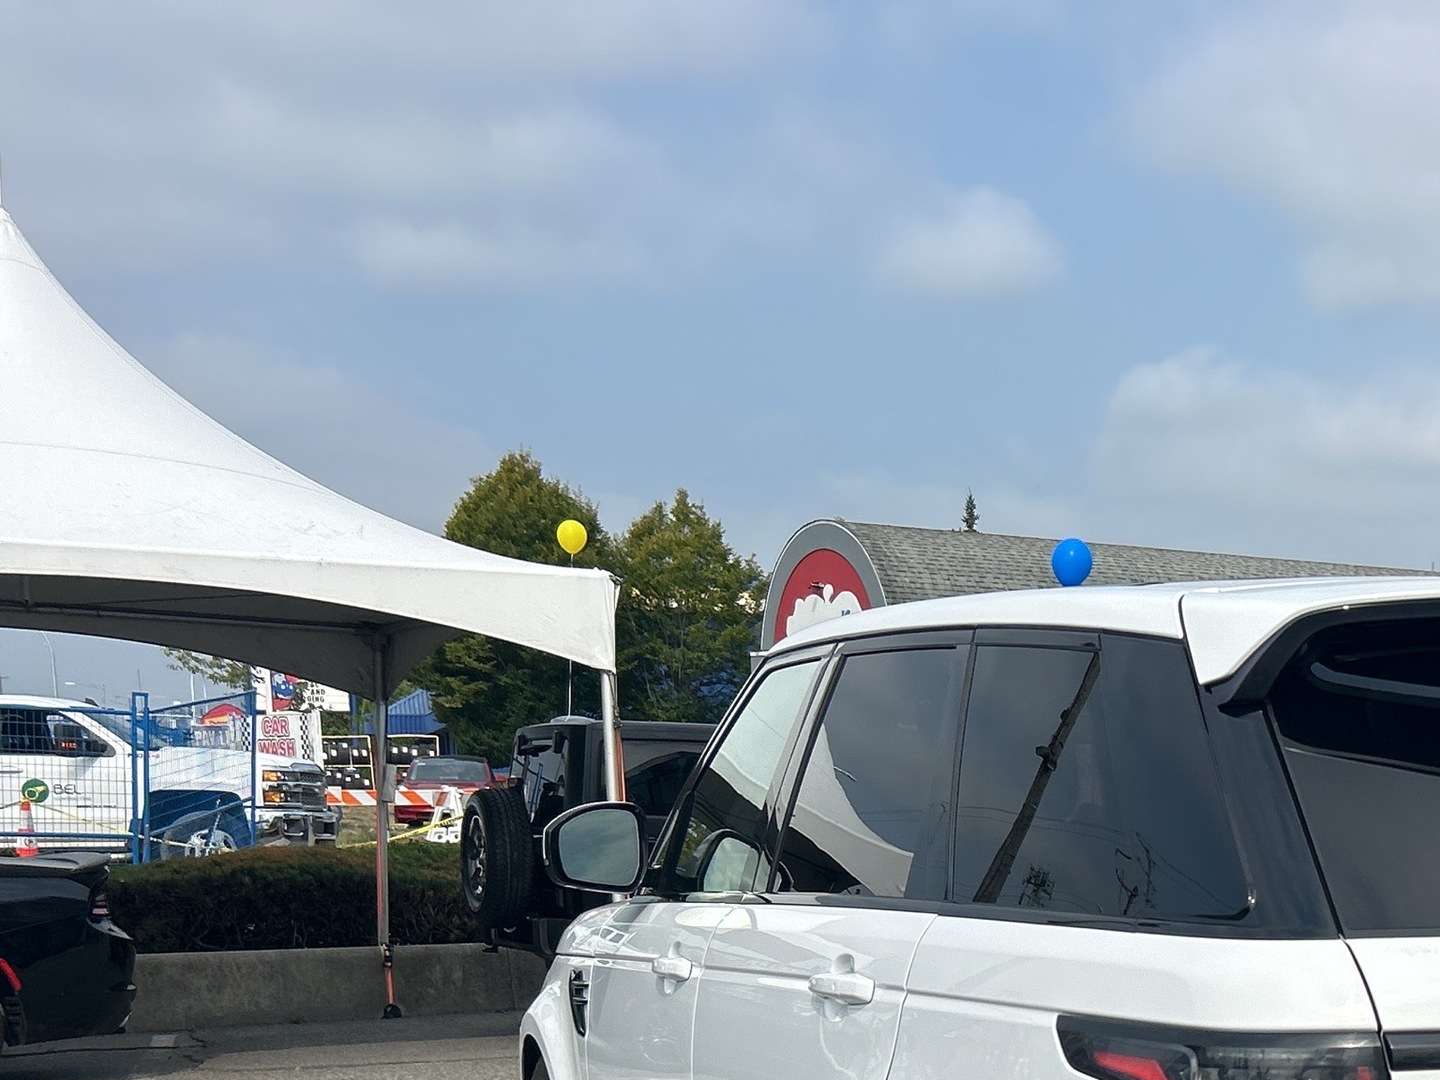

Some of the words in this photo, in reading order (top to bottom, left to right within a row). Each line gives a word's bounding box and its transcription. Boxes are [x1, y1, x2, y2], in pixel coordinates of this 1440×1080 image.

[262, 716, 289, 737] CAR
[257, 739, 296, 758] WASH
[53, 784, 82, 795] BEL
